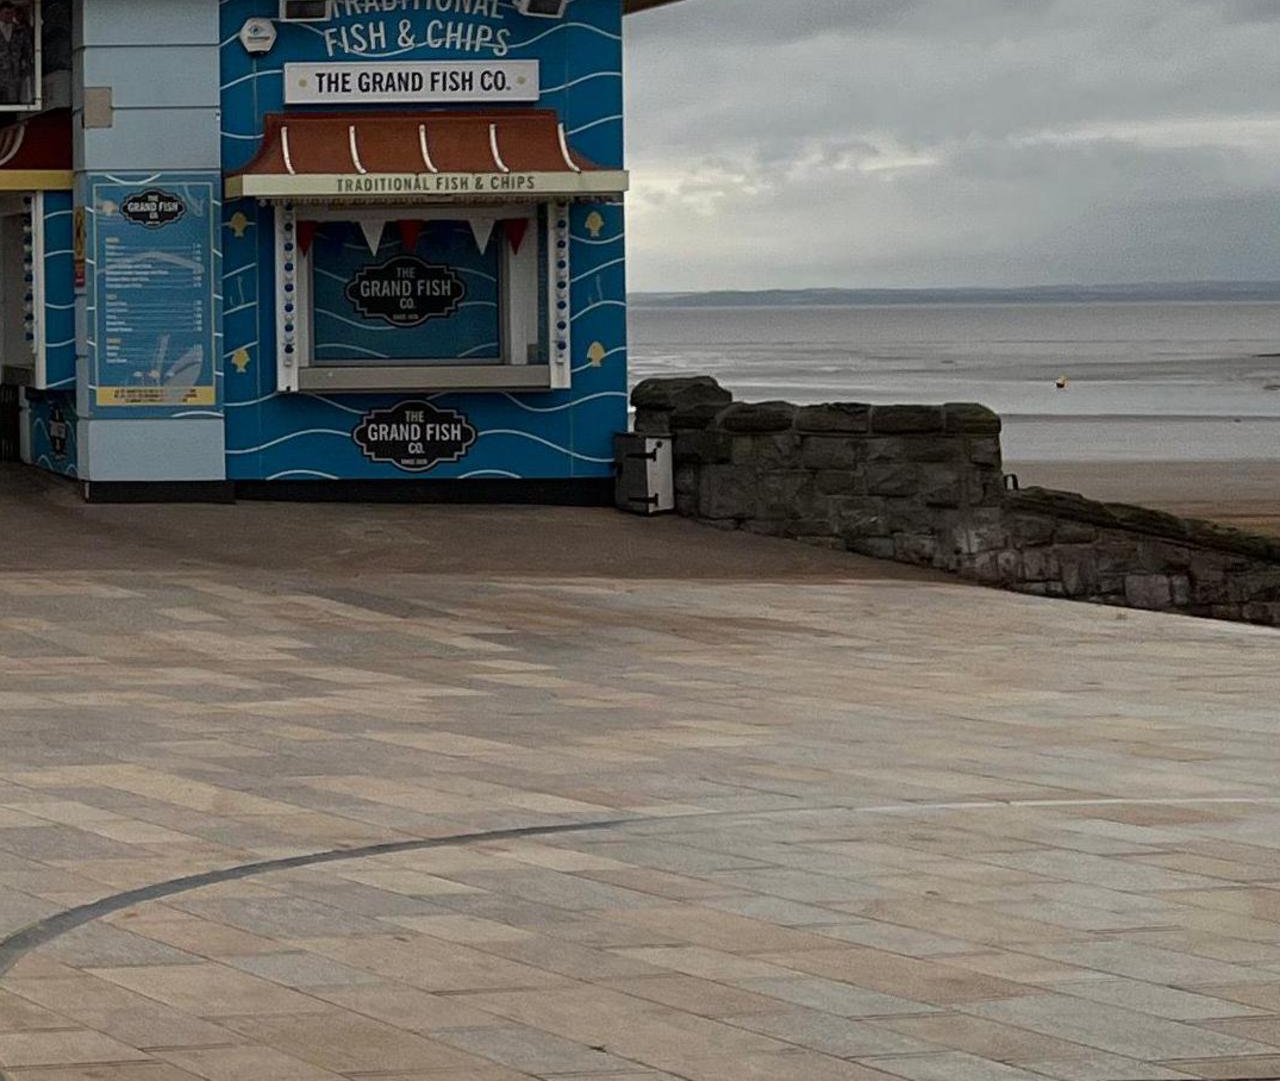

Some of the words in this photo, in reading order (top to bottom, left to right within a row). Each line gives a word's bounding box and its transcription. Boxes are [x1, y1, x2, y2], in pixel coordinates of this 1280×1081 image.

[324, 20, 386, 57] FISH
[397, 19, 416, 48] &
[426, 19, 511, 57] CHIPS
[315, 72, 351, 93] THE
[358, 72, 423, 92] GRAND
[430, 71, 473, 91] FISH
[480, 70, 512, 91] CO.
[337, 177, 429, 191] TRADITIONAL
[436, 177, 468, 190] FISH
[474, 176, 483, 190] &
[490, 175, 535, 189] CHIPS
[396, 267, 416, 278] THE
[360, 280, 412, 297] GRAND
[417, 279, 452, 297] FISH
[404, 410, 425, 422] THE
[367, 423, 421, 441] GRAND
[426, 423, 462, 441] FISH
